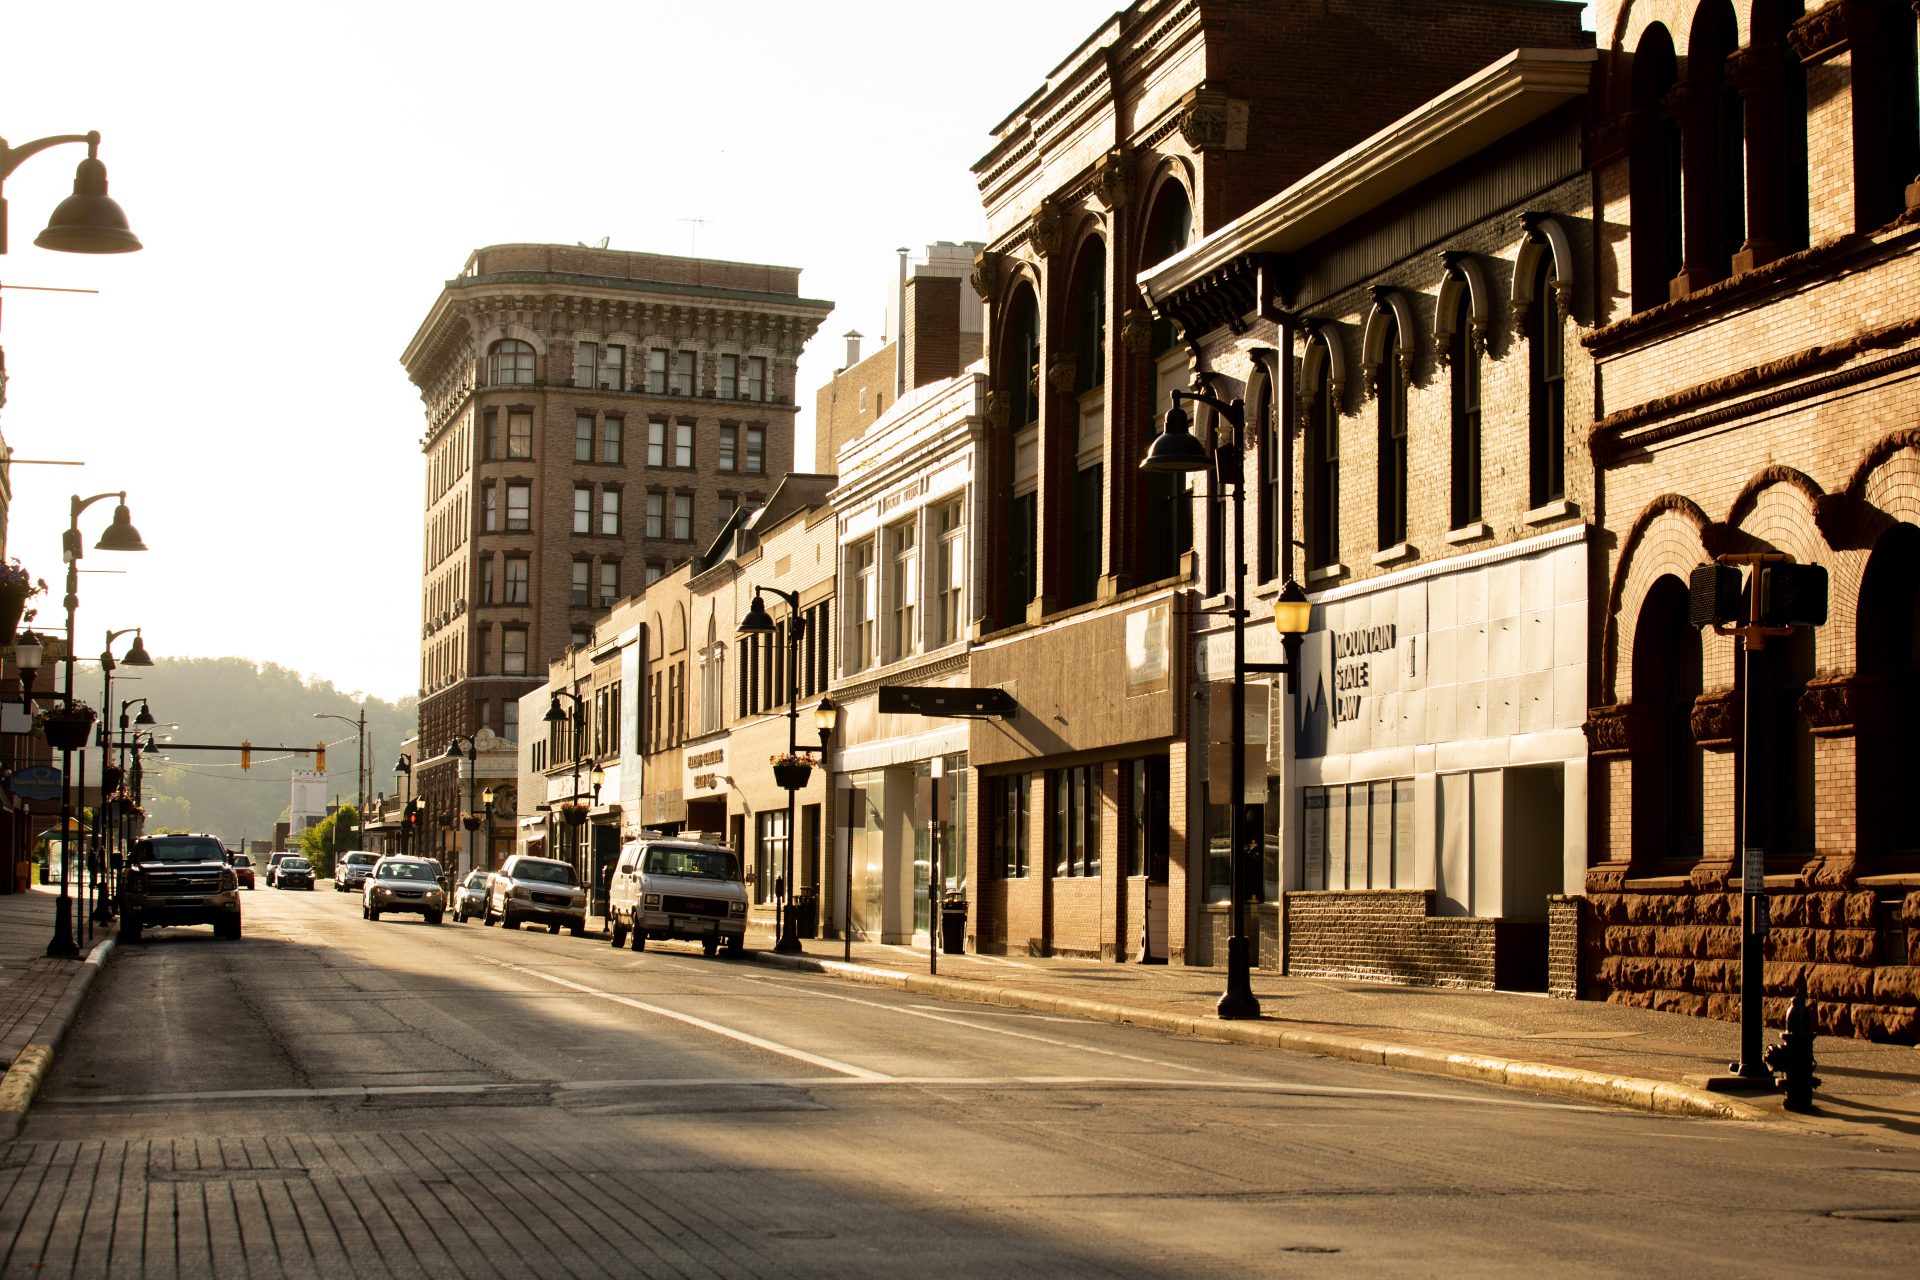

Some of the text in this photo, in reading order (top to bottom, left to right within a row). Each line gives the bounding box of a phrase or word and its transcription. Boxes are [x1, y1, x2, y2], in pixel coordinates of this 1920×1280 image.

[1336, 624, 1396, 659] MOUNTAIN
[1336, 662, 1369, 691] STATE
[1336, 695, 1361, 722] LAW
